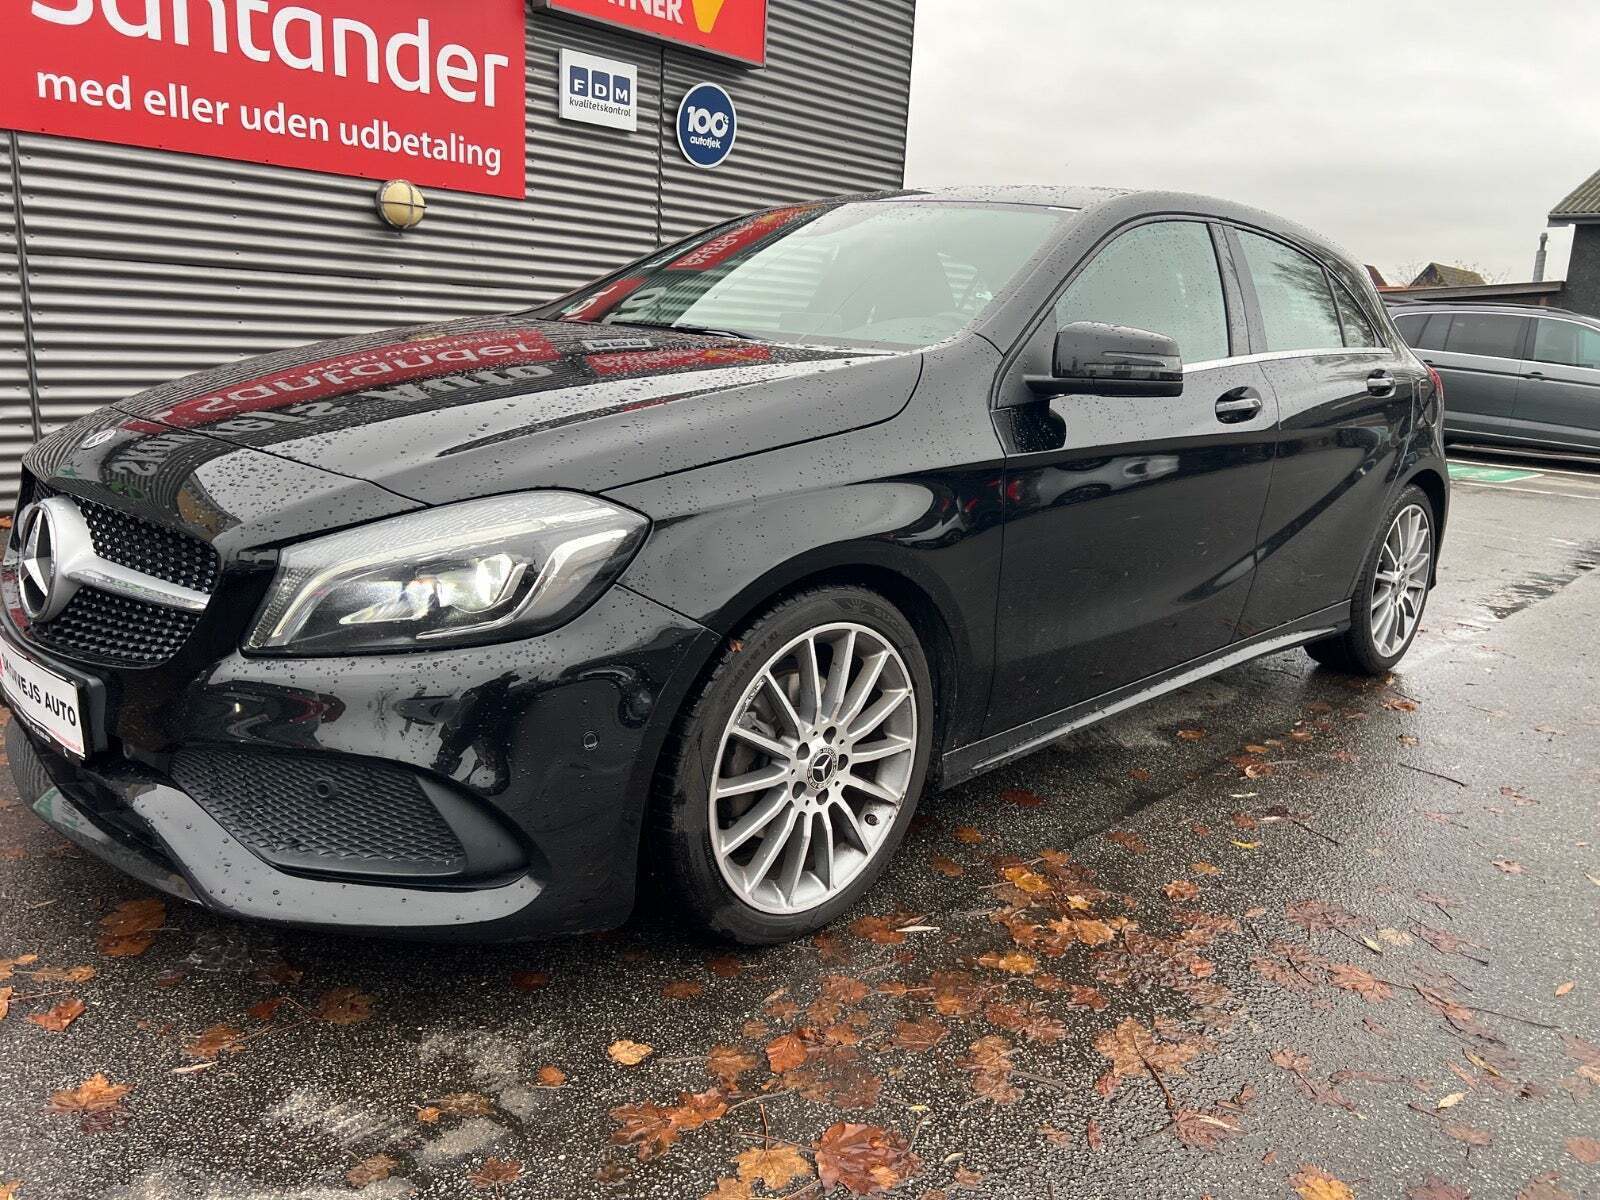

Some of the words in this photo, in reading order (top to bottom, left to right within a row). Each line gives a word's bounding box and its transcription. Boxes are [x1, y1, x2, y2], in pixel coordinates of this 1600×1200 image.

[572, 77, 629, 103] FDM
[569, 97, 631, 117] kvalitetskontrol
[36, 71, 132, 111] med
[143, 83, 230, 126] eller
[240, 102, 330, 142] uden
[339, 120, 502, 176] udbetaling
[689, 136, 721, 149] autotjek
[45, 691, 77, 727] AUTO
